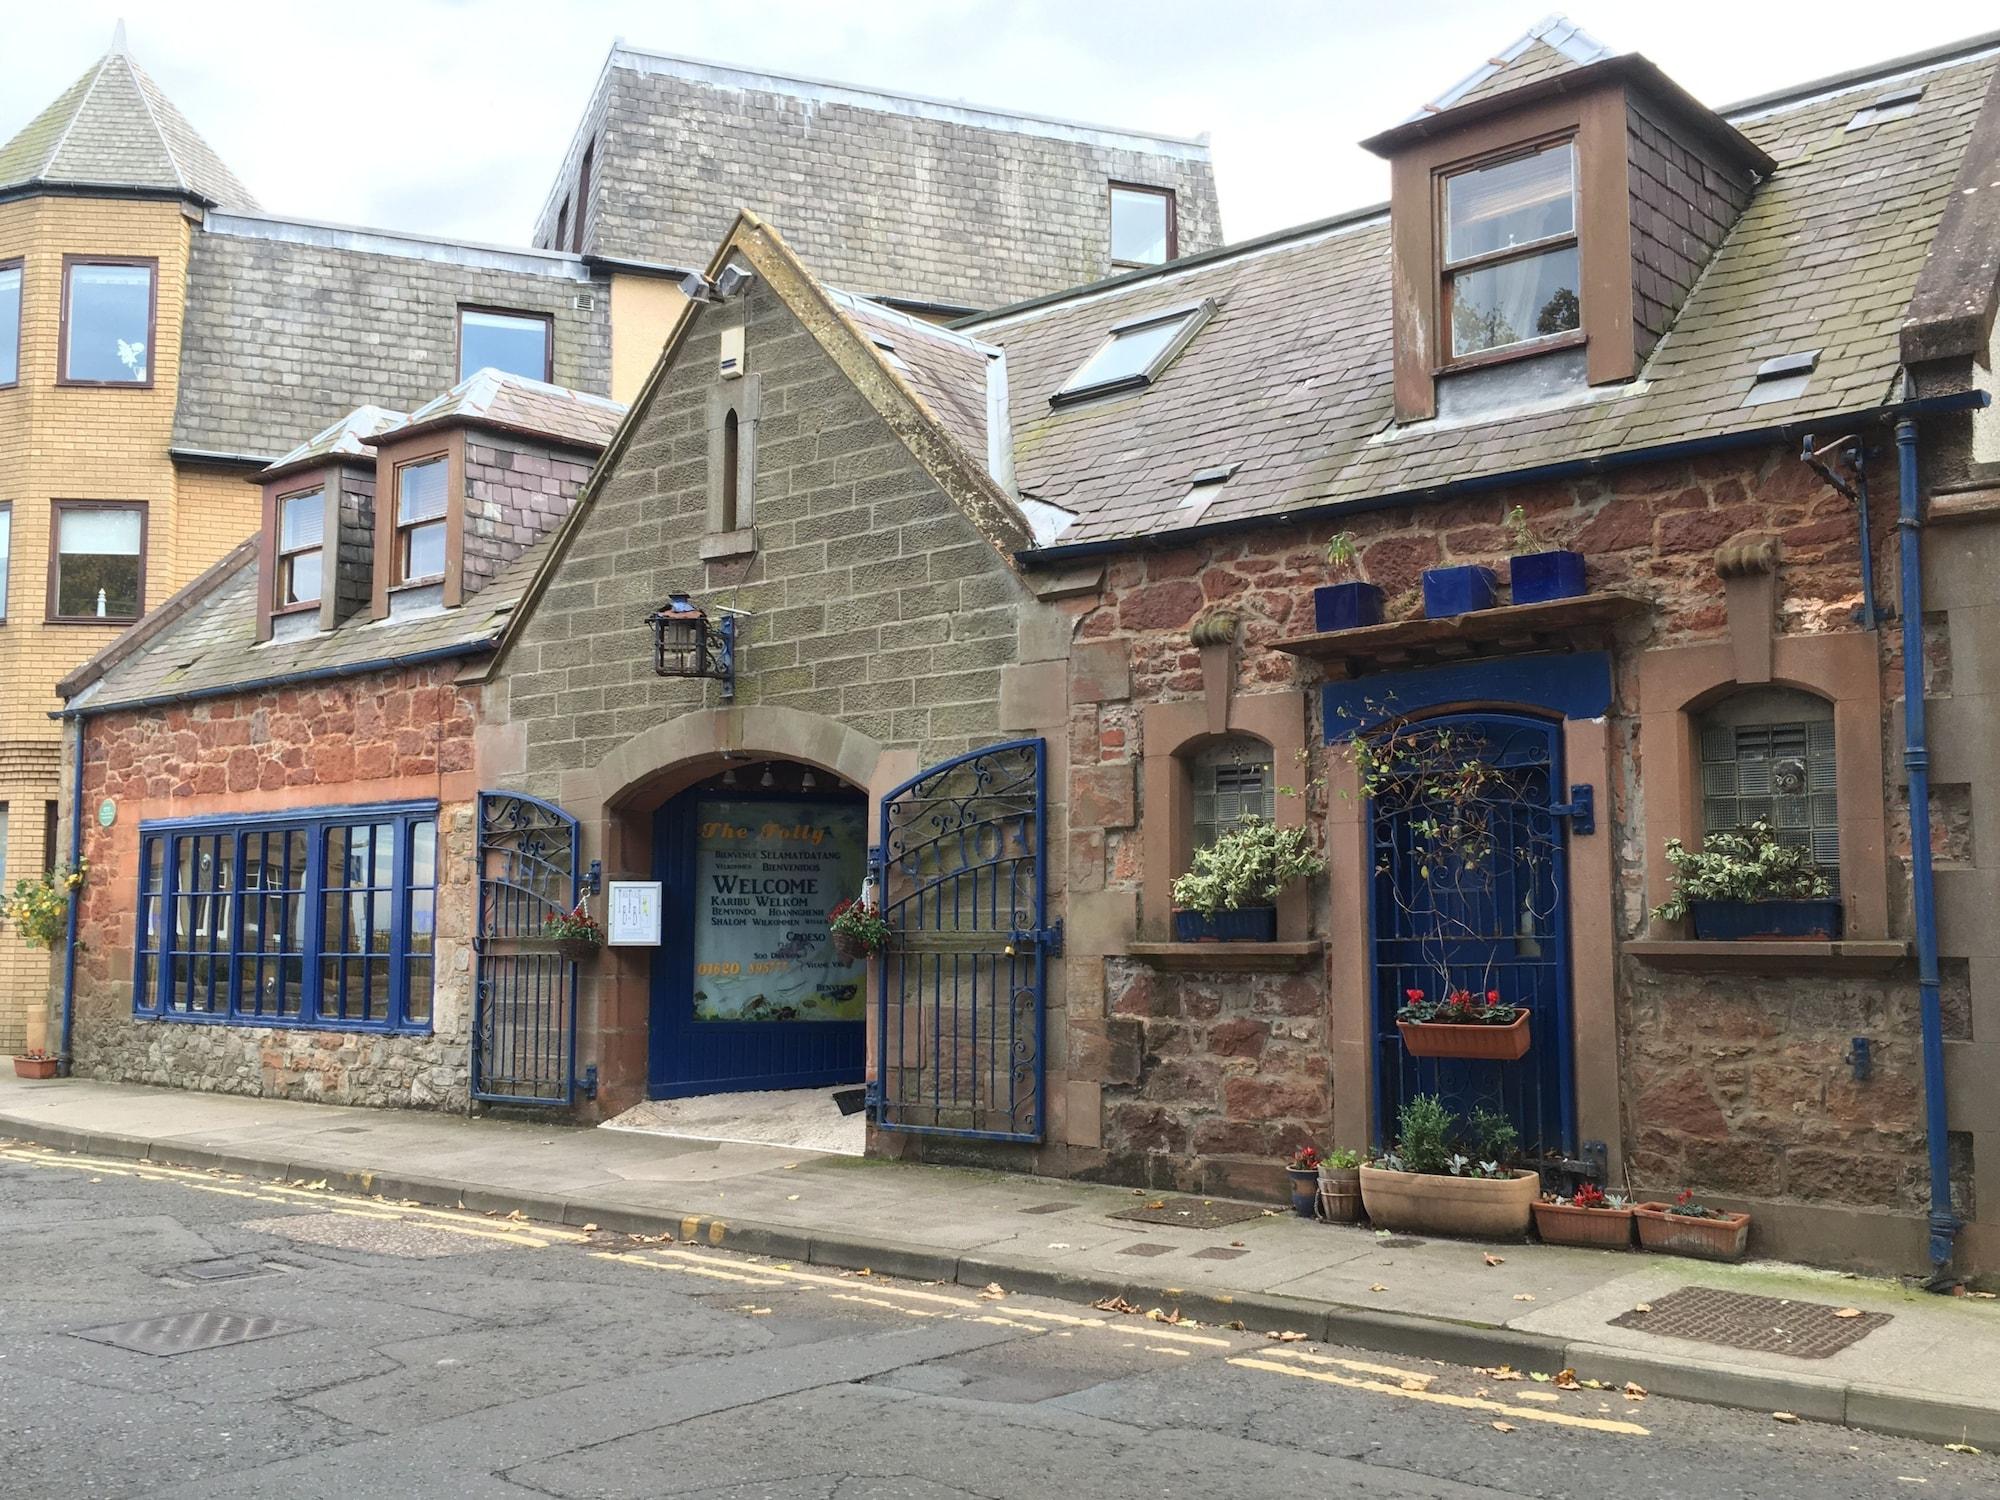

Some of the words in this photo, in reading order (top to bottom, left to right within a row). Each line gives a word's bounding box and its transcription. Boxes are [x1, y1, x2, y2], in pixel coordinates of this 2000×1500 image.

[702, 822, 748, 839] The
[760, 822, 825, 846] Folly
[711, 874, 819, 894] WELCOME
[711, 896, 750, 906] KARIBU
[711, 917, 747, 926] SHALOM
[697, 961, 741, 976] 01620
